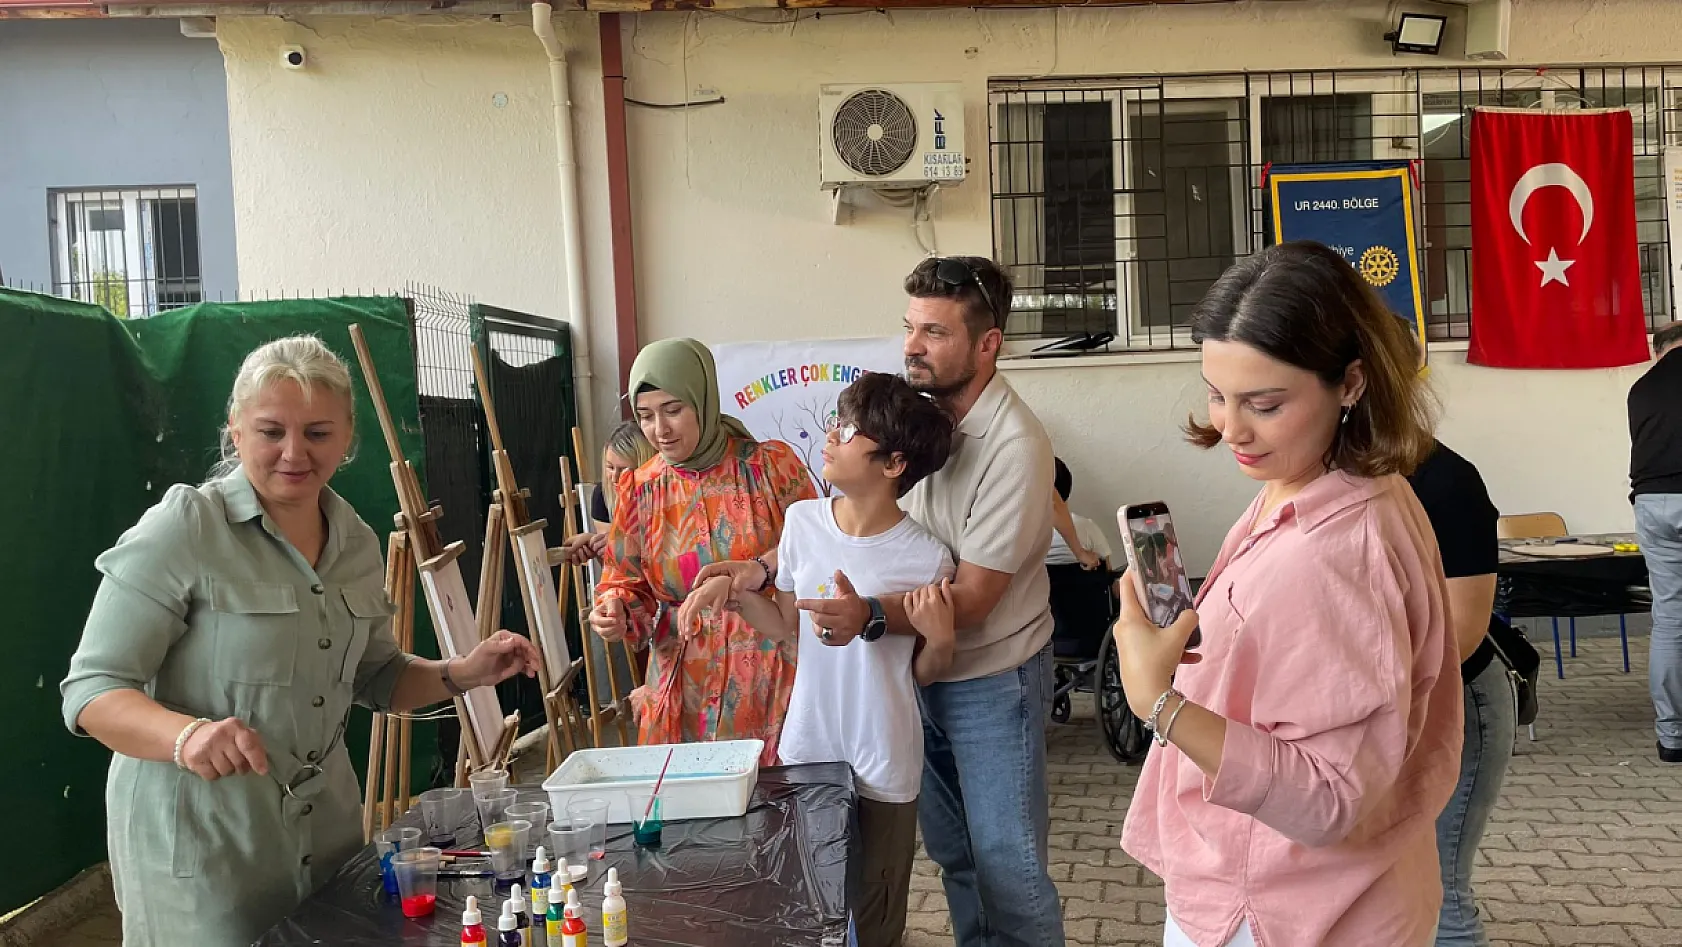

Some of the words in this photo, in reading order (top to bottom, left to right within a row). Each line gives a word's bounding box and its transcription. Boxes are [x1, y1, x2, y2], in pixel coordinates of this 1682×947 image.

[1294, 201, 1310, 211] UR
[1312, 200, 1340, 211] 2440.
[1343, 197, 1379, 209] BÖLGE
[734, 367, 798, 409] RENKLER
[801, 363, 829, 387] ÇOK
[833, 364, 869, 382] ENG
